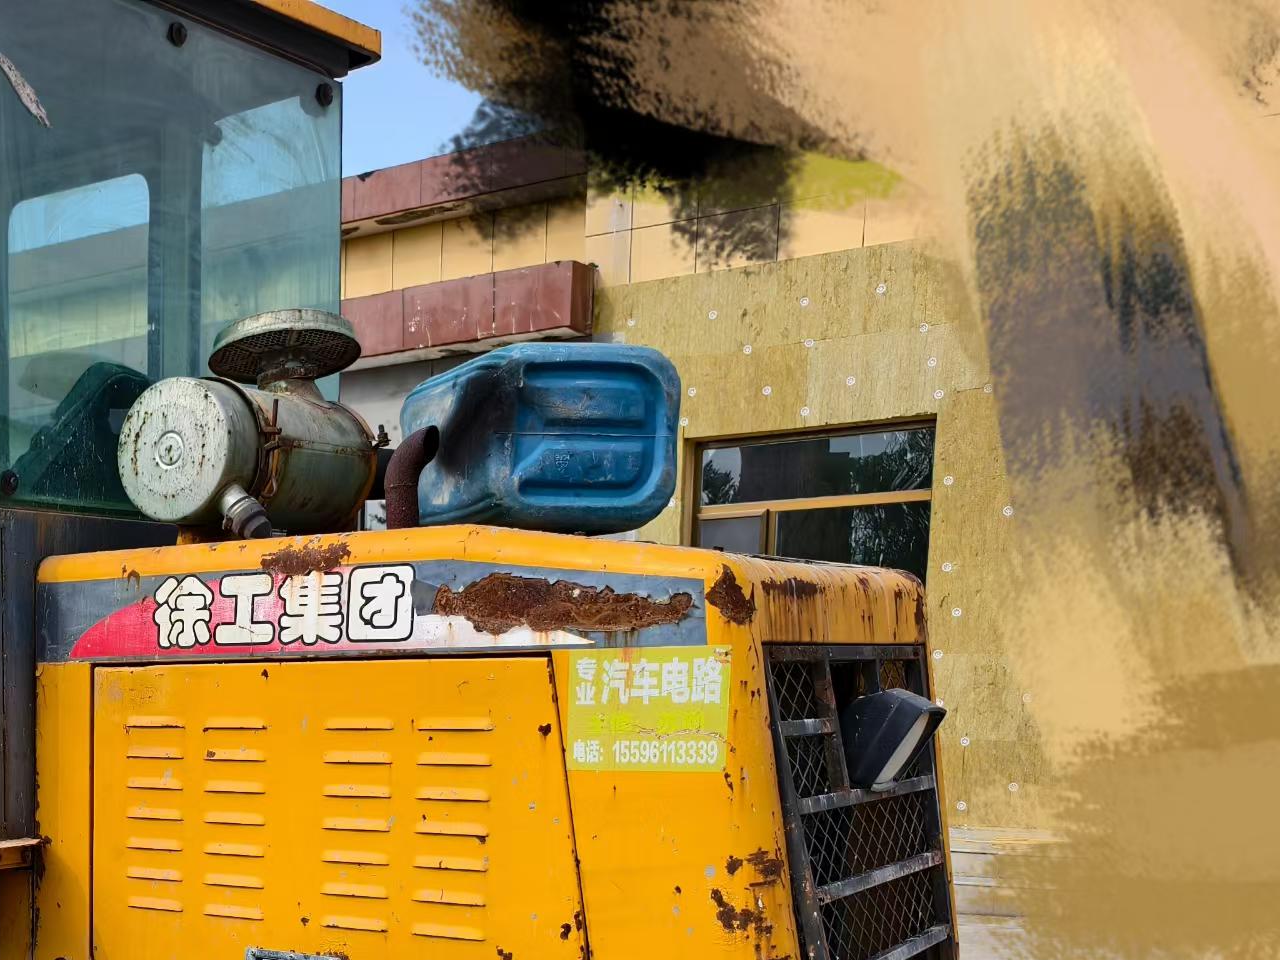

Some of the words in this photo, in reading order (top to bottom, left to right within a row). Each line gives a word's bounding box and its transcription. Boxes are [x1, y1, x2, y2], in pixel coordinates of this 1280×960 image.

[154, 563, 416, 649] 徐工集团
[601, 656, 722, 704] 汽车电路
[612, 739, 718, 765] 15596113339
